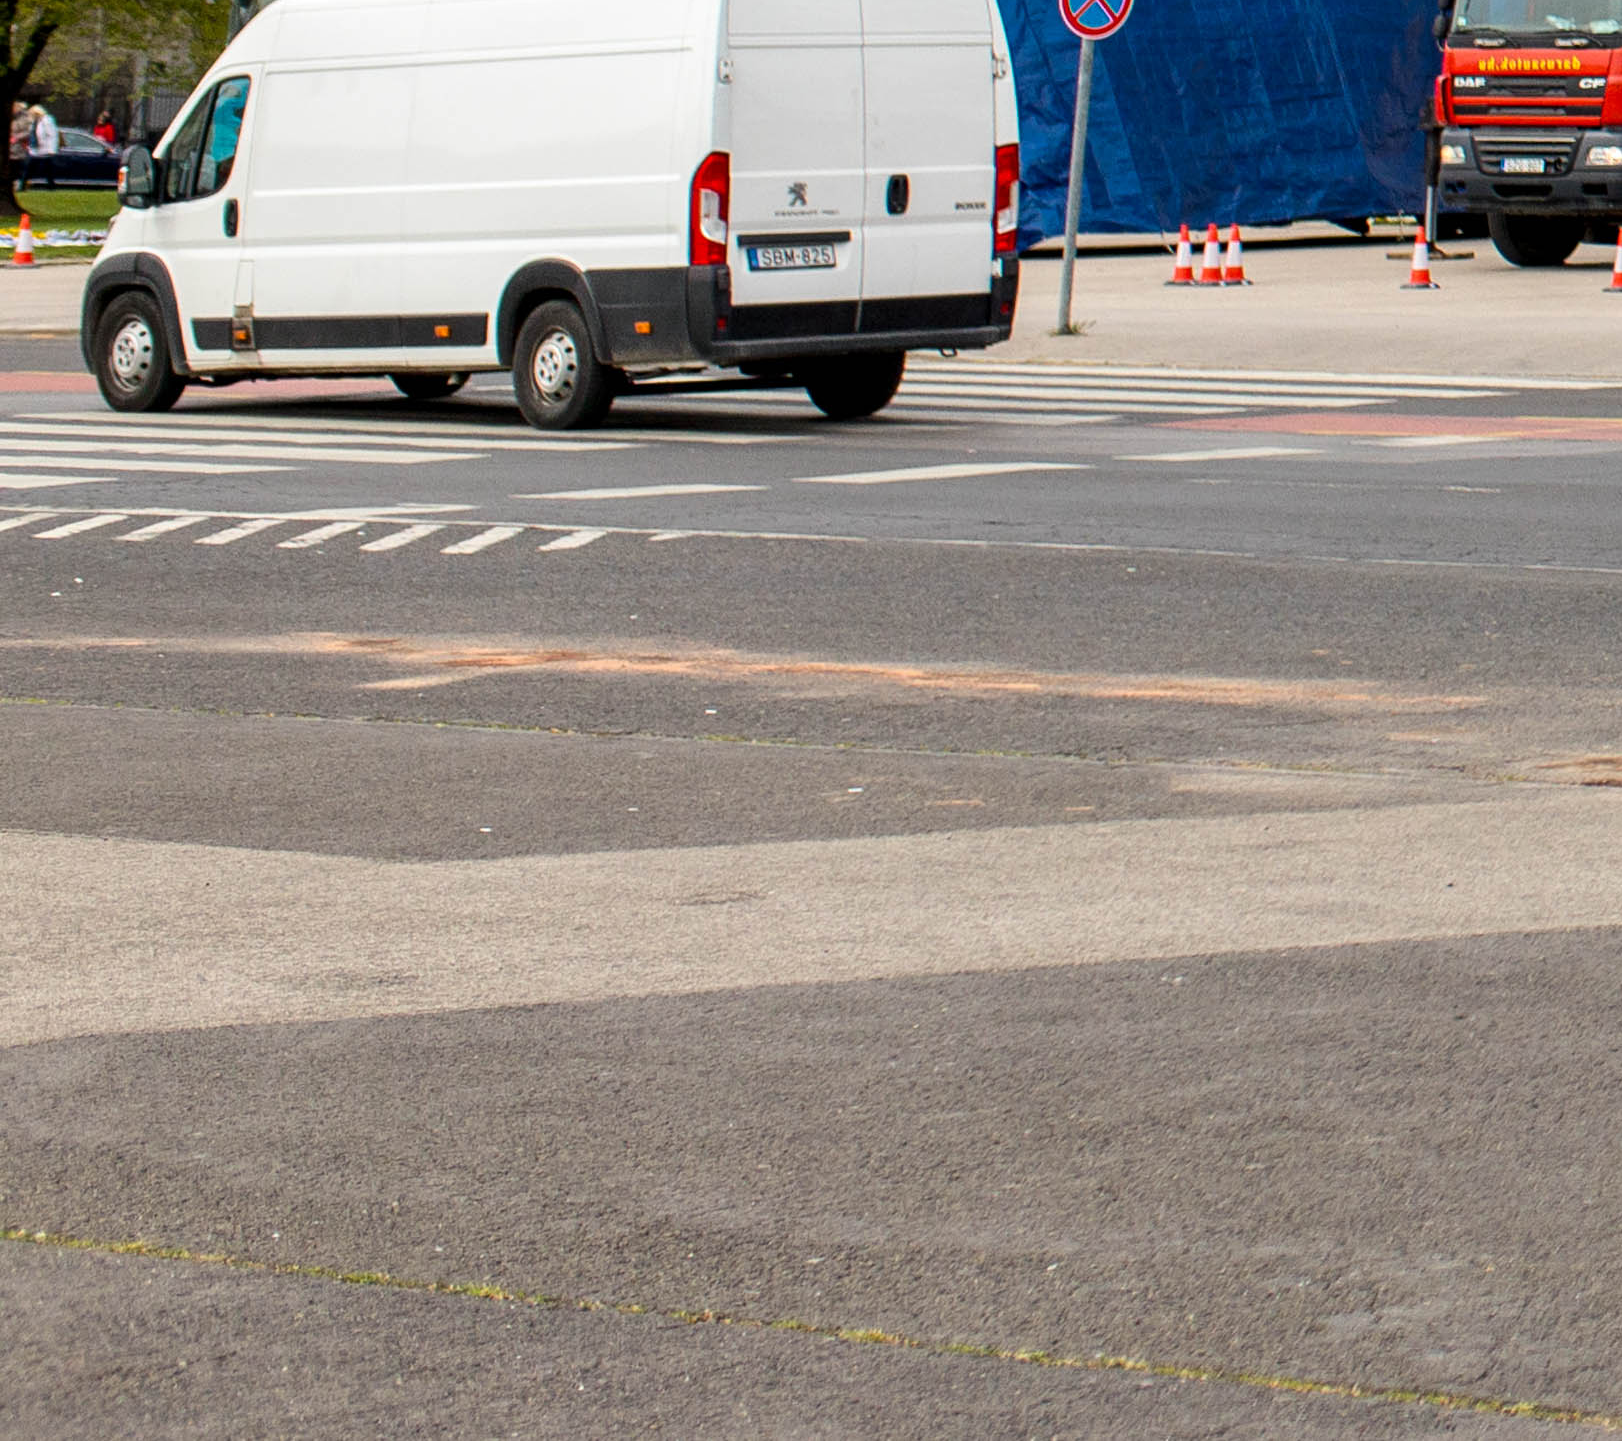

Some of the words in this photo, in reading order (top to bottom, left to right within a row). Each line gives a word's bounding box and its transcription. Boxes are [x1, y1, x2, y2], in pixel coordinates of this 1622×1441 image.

[1453, 76, 1487, 89] DAF
[1578, 77, 1607, 90] CF
[760, 246, 832, 267] SBM-825
